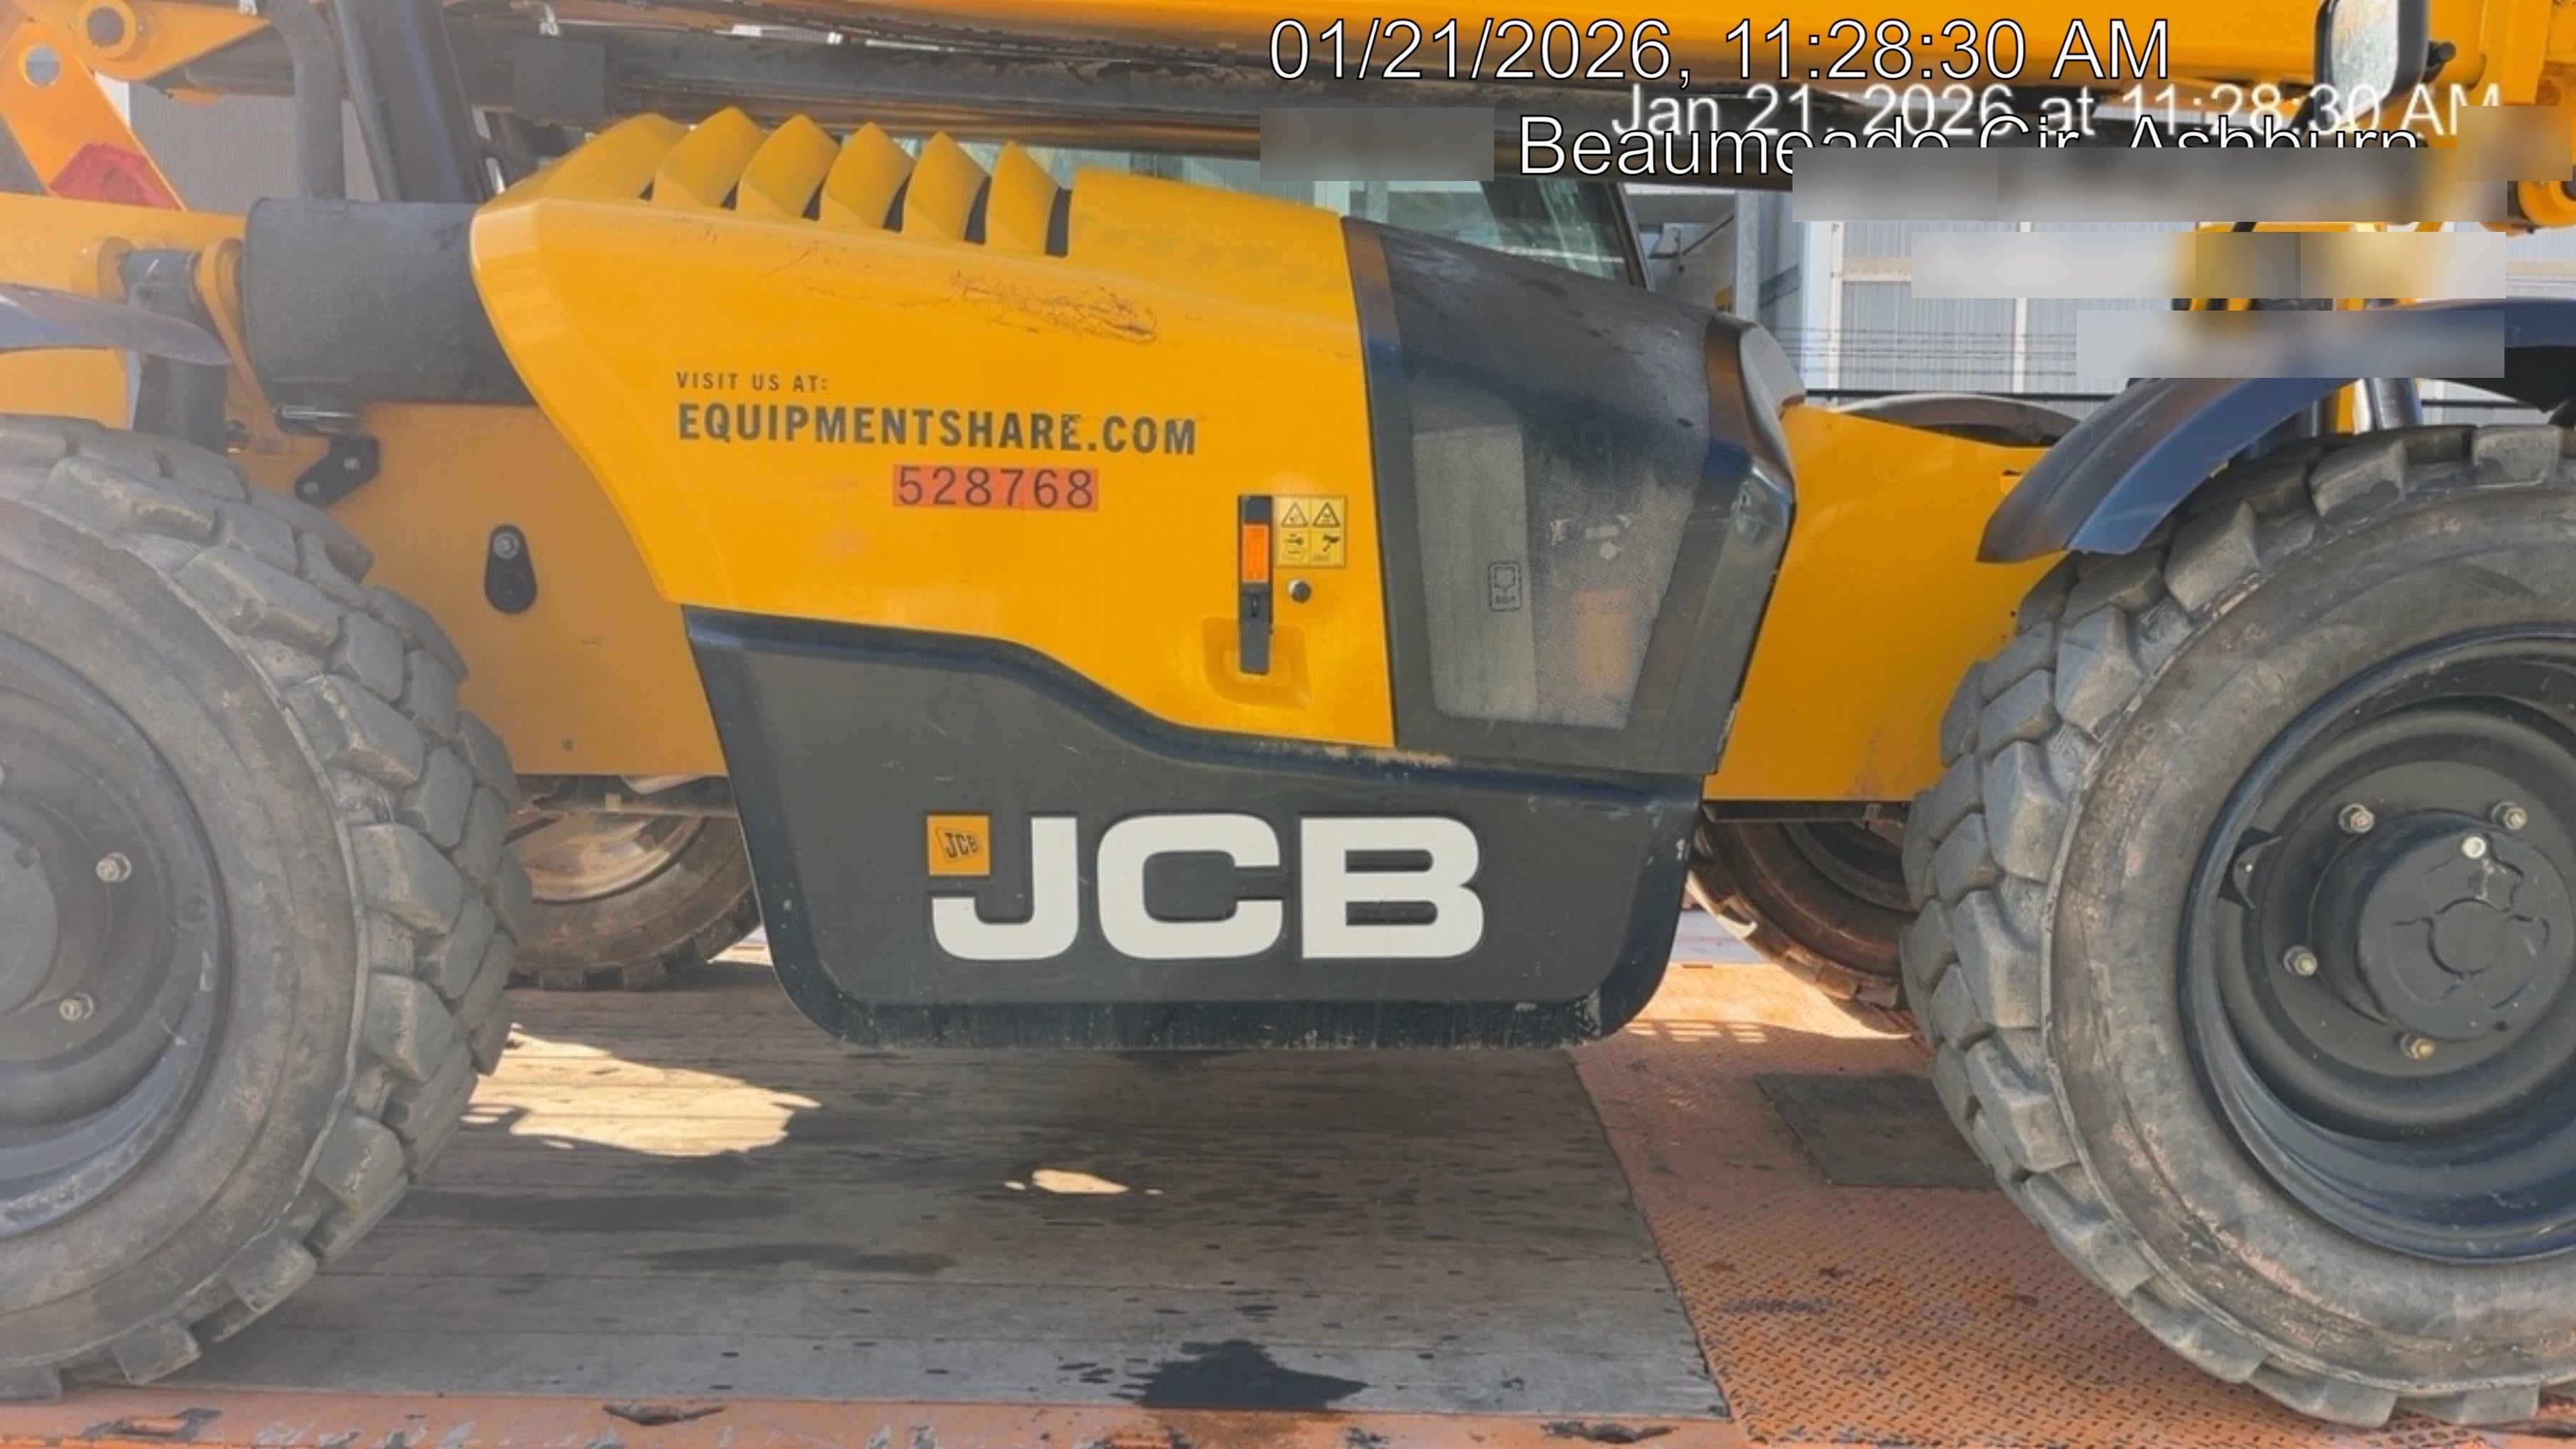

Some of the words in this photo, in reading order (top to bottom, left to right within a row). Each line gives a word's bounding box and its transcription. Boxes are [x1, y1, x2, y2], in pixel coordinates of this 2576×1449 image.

[676, 371, 738, 391] VISIT
[752, 374, 781, 392] US
[793, 375, 828, 393] AT:
[679, 402, 1196, 456] EQUIPMENTSHARE.COM
[897, 465, 1095, 509] 528768
[944, 831, 980, 859] JCB
[932, 814, 1484, 960] JCB
